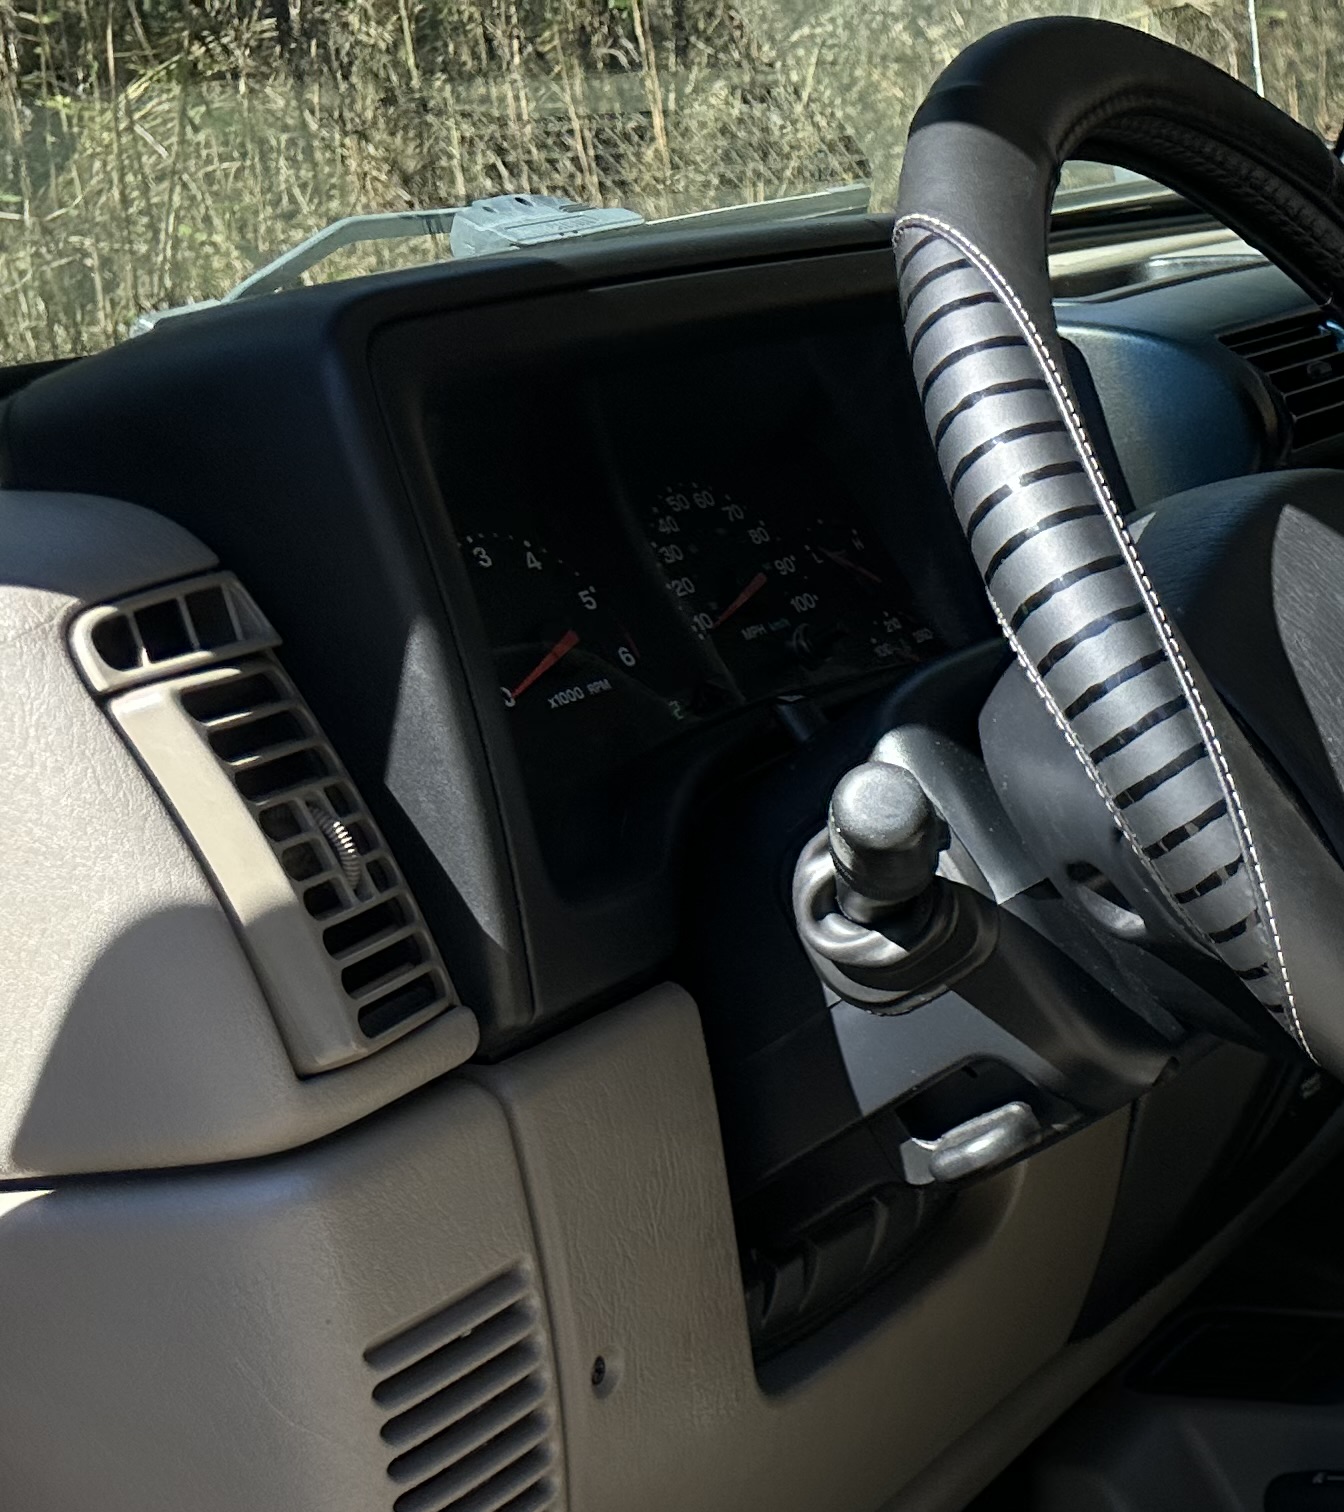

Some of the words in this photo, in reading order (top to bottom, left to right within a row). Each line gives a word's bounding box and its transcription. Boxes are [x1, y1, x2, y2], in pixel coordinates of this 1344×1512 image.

[665, 493, 690, 512] 50
[693, 490, 715, 509] 60
[721, 504, 744, 522] 70
[658, 515, 680, 534] 40
[747, 527, 770, 544] 80
[472, 546, 493, 569] 3
[525, 551, 543, 571] 4
[658, 544, 684, 563] 30
[773, 556, 796, 576] 90
[671, 576, 696, 597] 20
[577, 589, 598, 611] 5
[789, 592, 817, 614] 100
[693, 612, 714, 632] 10
[617, 646, 637, 668] 6
[546, 686, 585, 710] x1000
[586, 677, 613, 696] RPM
